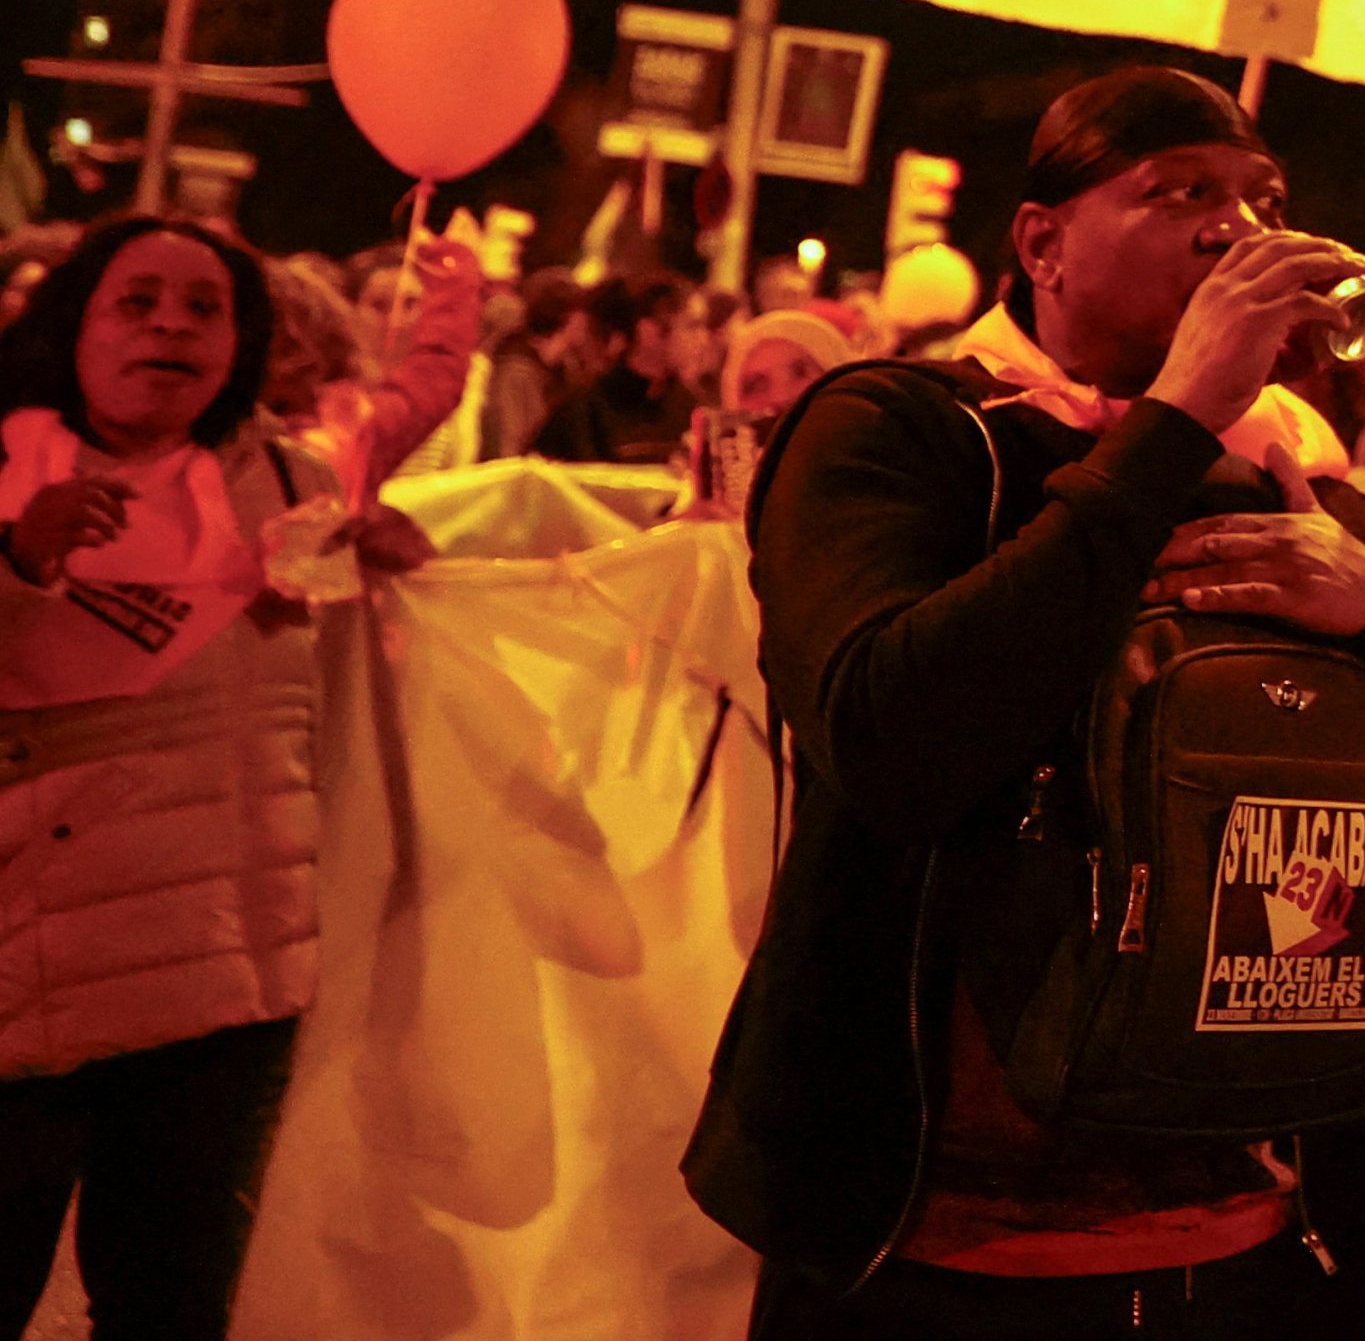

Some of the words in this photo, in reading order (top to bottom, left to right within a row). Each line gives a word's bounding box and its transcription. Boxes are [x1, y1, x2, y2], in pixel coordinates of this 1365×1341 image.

[1224, 805, 1283, 885] S'HA
[1280, 861, 1324, 912] 23
[1212, 956, 1333, 983] ABAIXEM
[1227, 982, 1363, 1009] LLOGUERS
